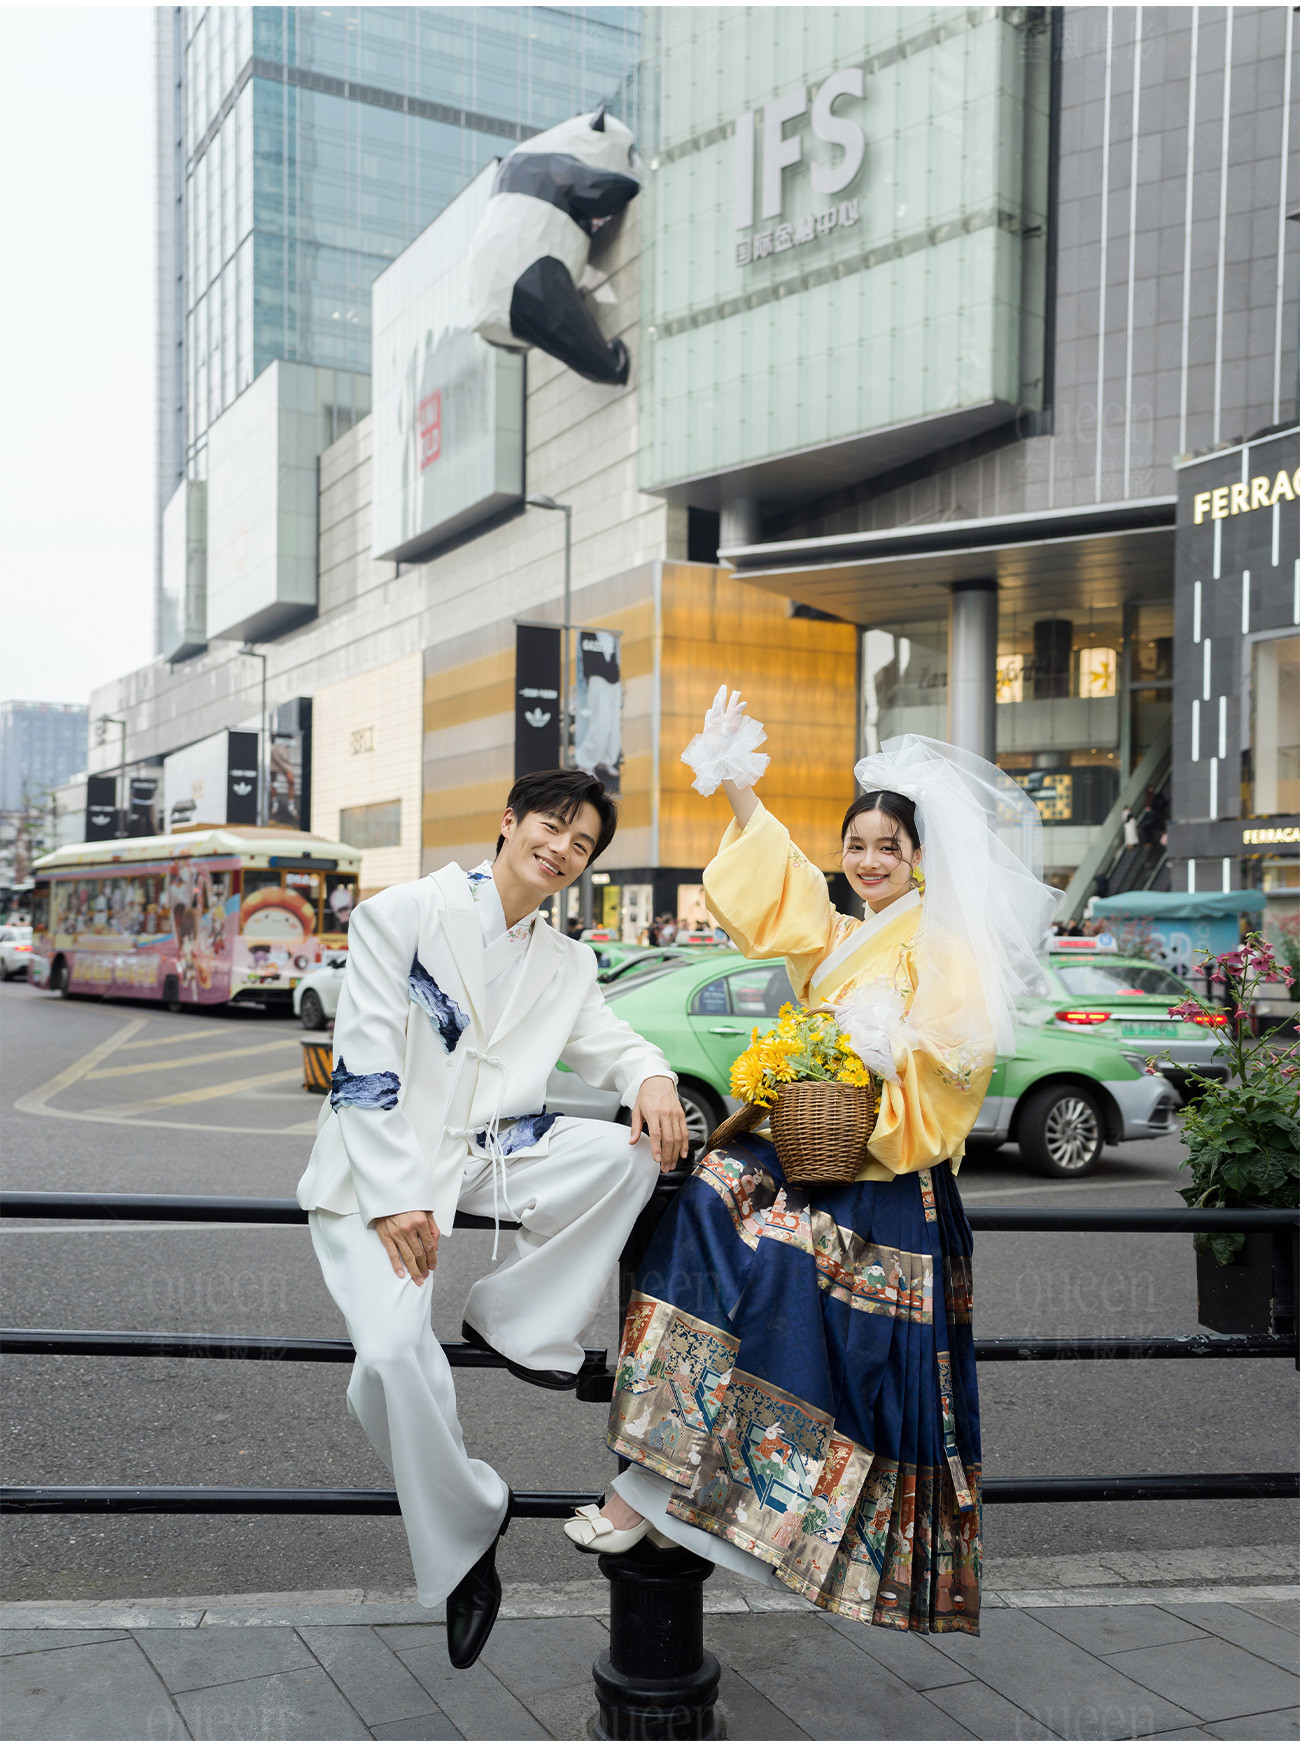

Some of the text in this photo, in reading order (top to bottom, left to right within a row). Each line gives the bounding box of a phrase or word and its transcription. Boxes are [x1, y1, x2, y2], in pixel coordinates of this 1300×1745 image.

[735, 68, 865, 231] IFS
[735, 199, 859, 268] 国际金融中心
